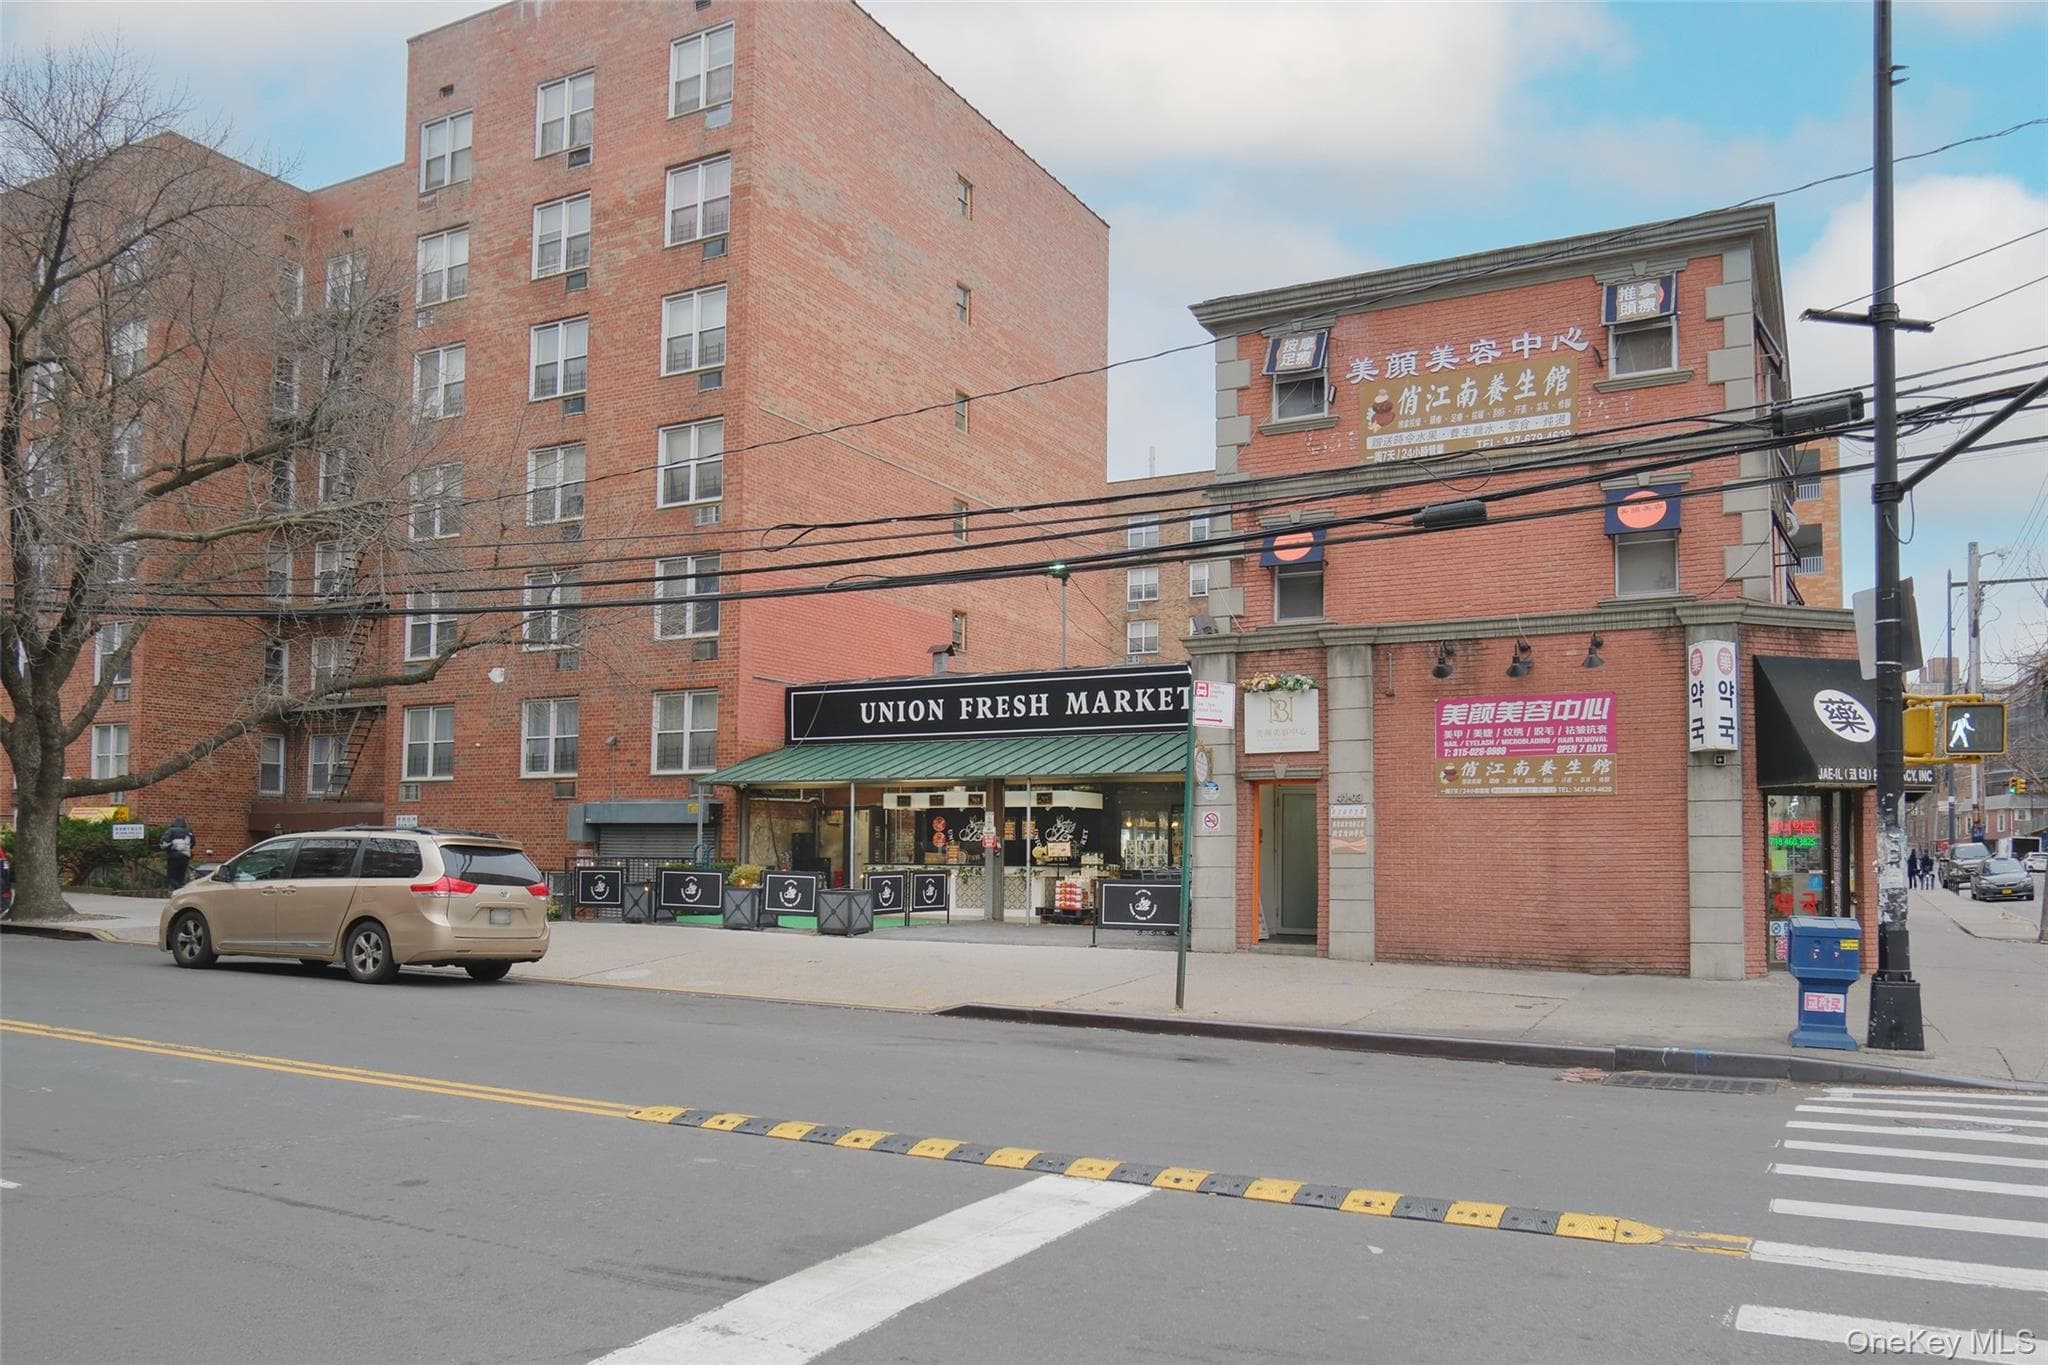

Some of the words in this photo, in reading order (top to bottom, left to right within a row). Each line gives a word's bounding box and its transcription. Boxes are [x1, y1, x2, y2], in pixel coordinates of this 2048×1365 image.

[1398, 364, 1571, 416] 俏江南養生館
[860, 699, 944, 724] UNION
[959, 692, 1050, 720] FRESH
[1065, 686, 1190, 715] MARKET
[1440, 697, 1611, 726] 美颜美容中心
[1691, 680, 1704, 745] 약국
[1718, 680, 1735, 745] 약국
[1819, 697, 1870, 734] 藥
[1465, 739, 1494, 747] EYELASH
[1576, 735, 1608, 743] REMOVAL
[1557, 745, 1578, 753] OPEN
[1586, 743, 1608, 753] DAYS
[1818, 768, 1843, 781] JAE-IL
[1918, 769, 1933, 782] INC
